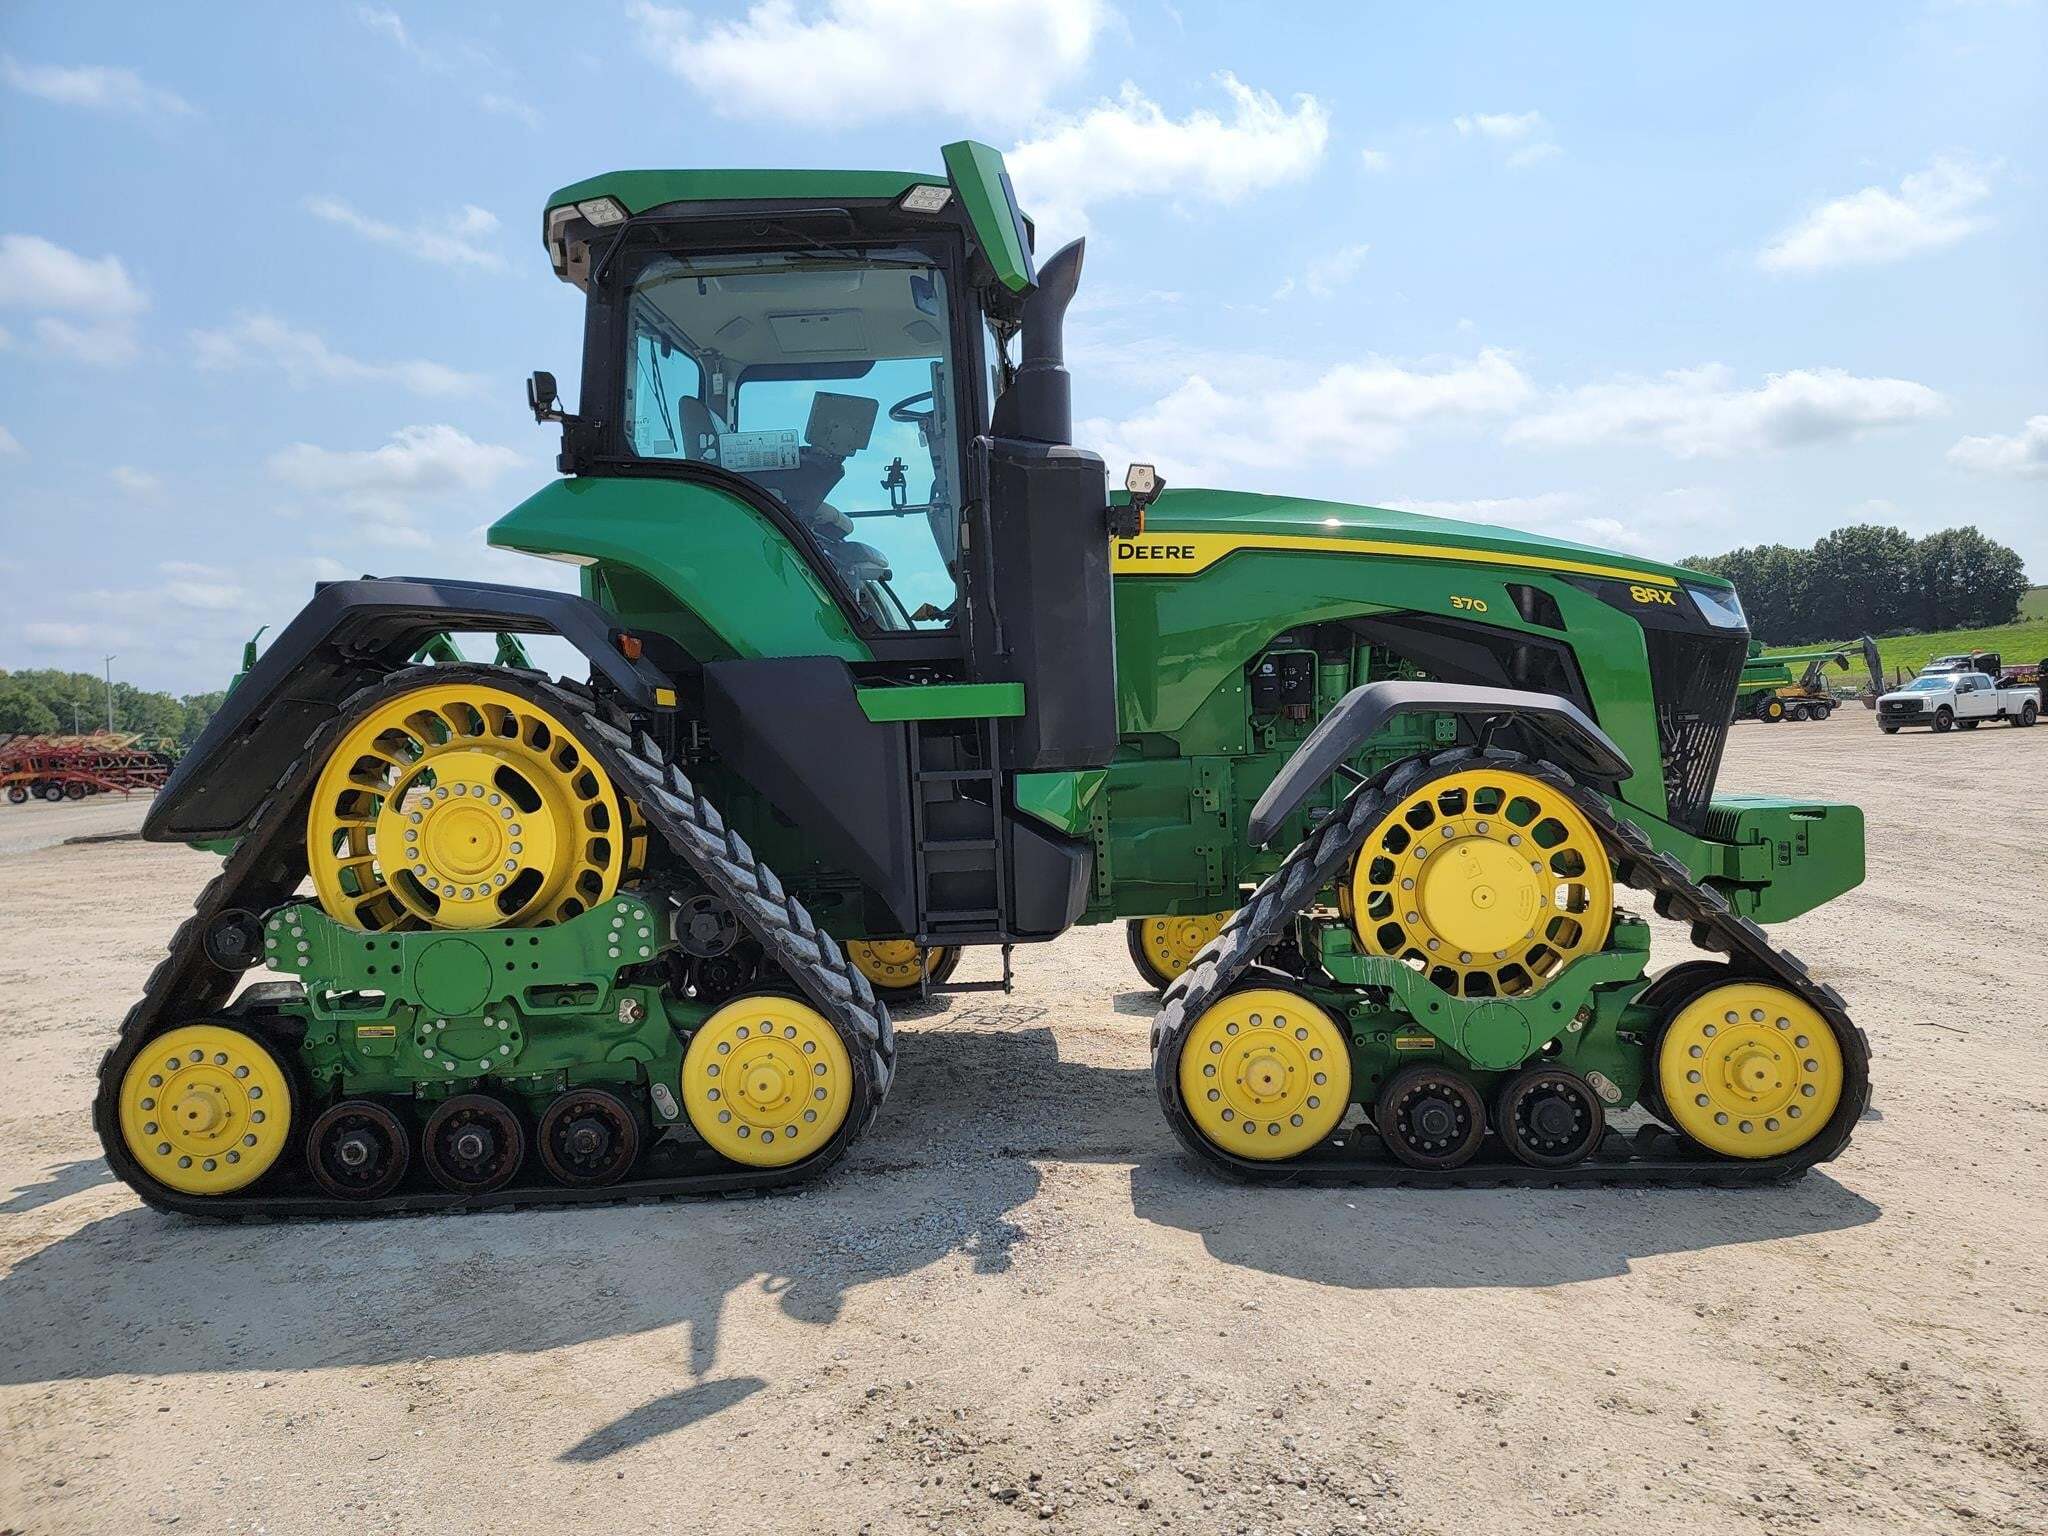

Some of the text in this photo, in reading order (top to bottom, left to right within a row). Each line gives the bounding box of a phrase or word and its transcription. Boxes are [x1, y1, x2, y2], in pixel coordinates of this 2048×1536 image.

[1118, 543, 1196, 559] DEERE
[1630, 585, 1677, 606] 8RX
[1450, 596, 1488, 612] 370
